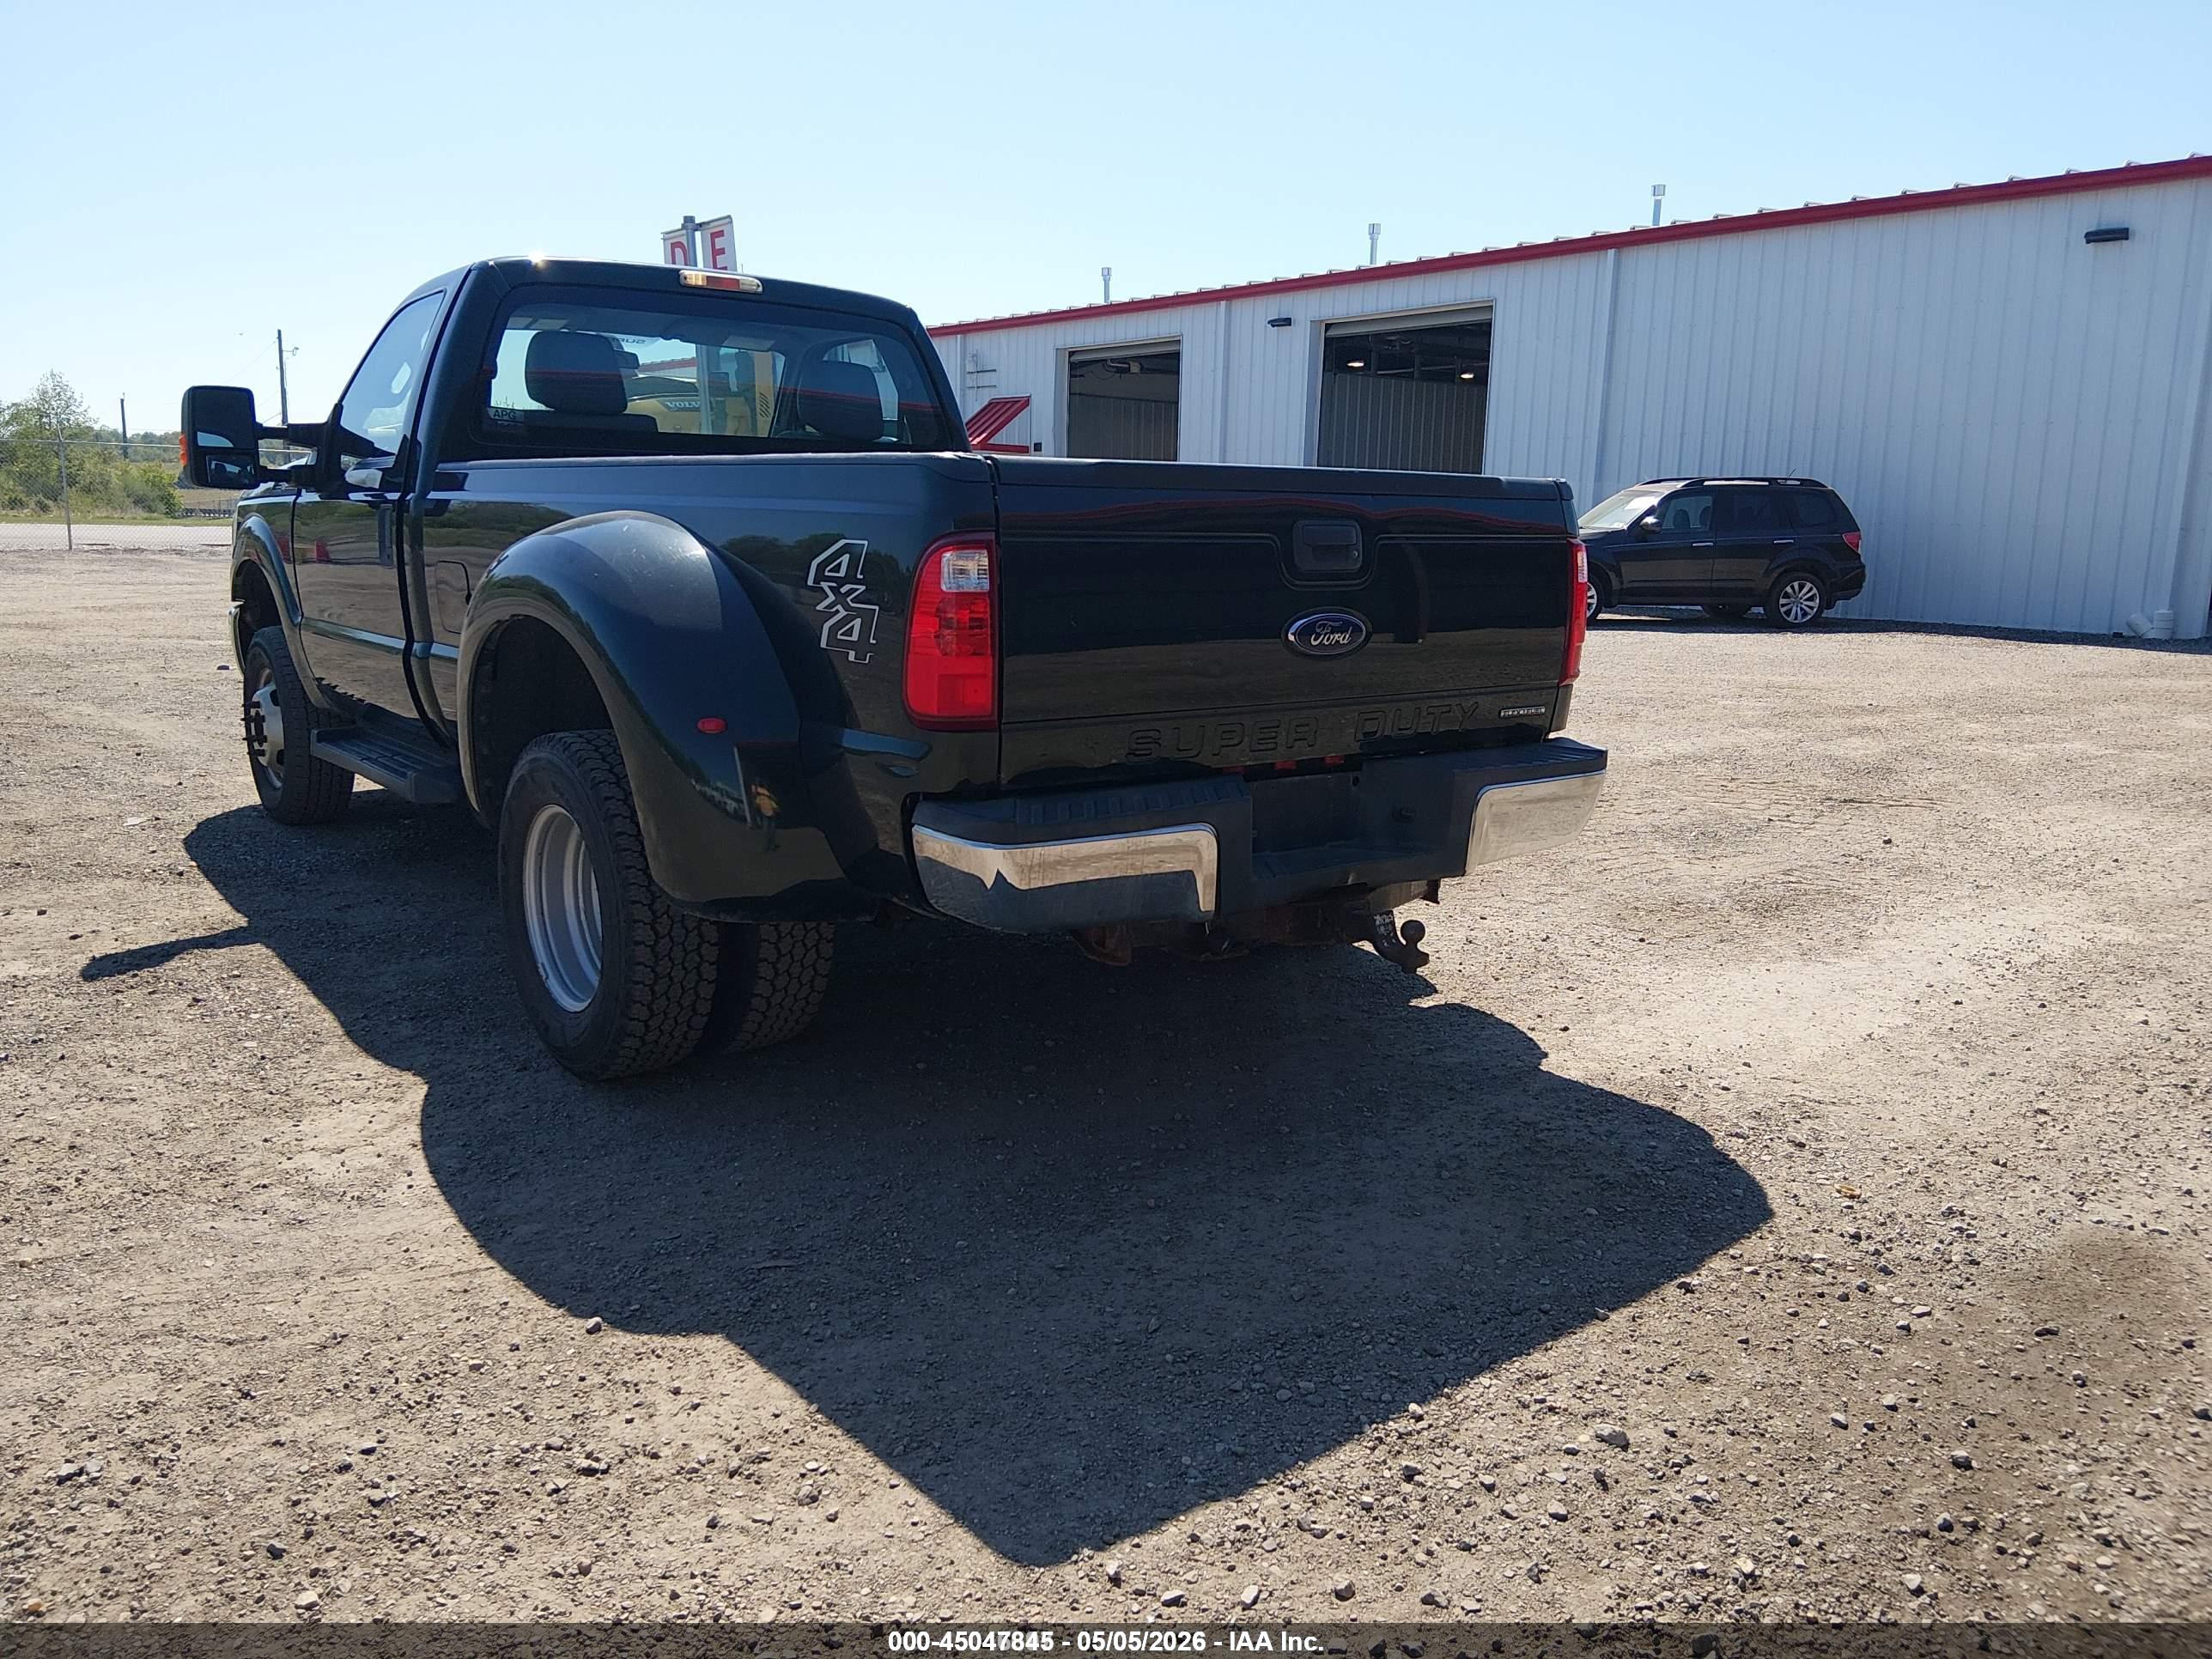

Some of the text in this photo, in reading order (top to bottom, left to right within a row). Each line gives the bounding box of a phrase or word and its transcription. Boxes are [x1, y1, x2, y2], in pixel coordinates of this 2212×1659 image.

[1310, 621, 1352, 646] Ford
[1125, 702, 1479, 765] SUPER DUTY
